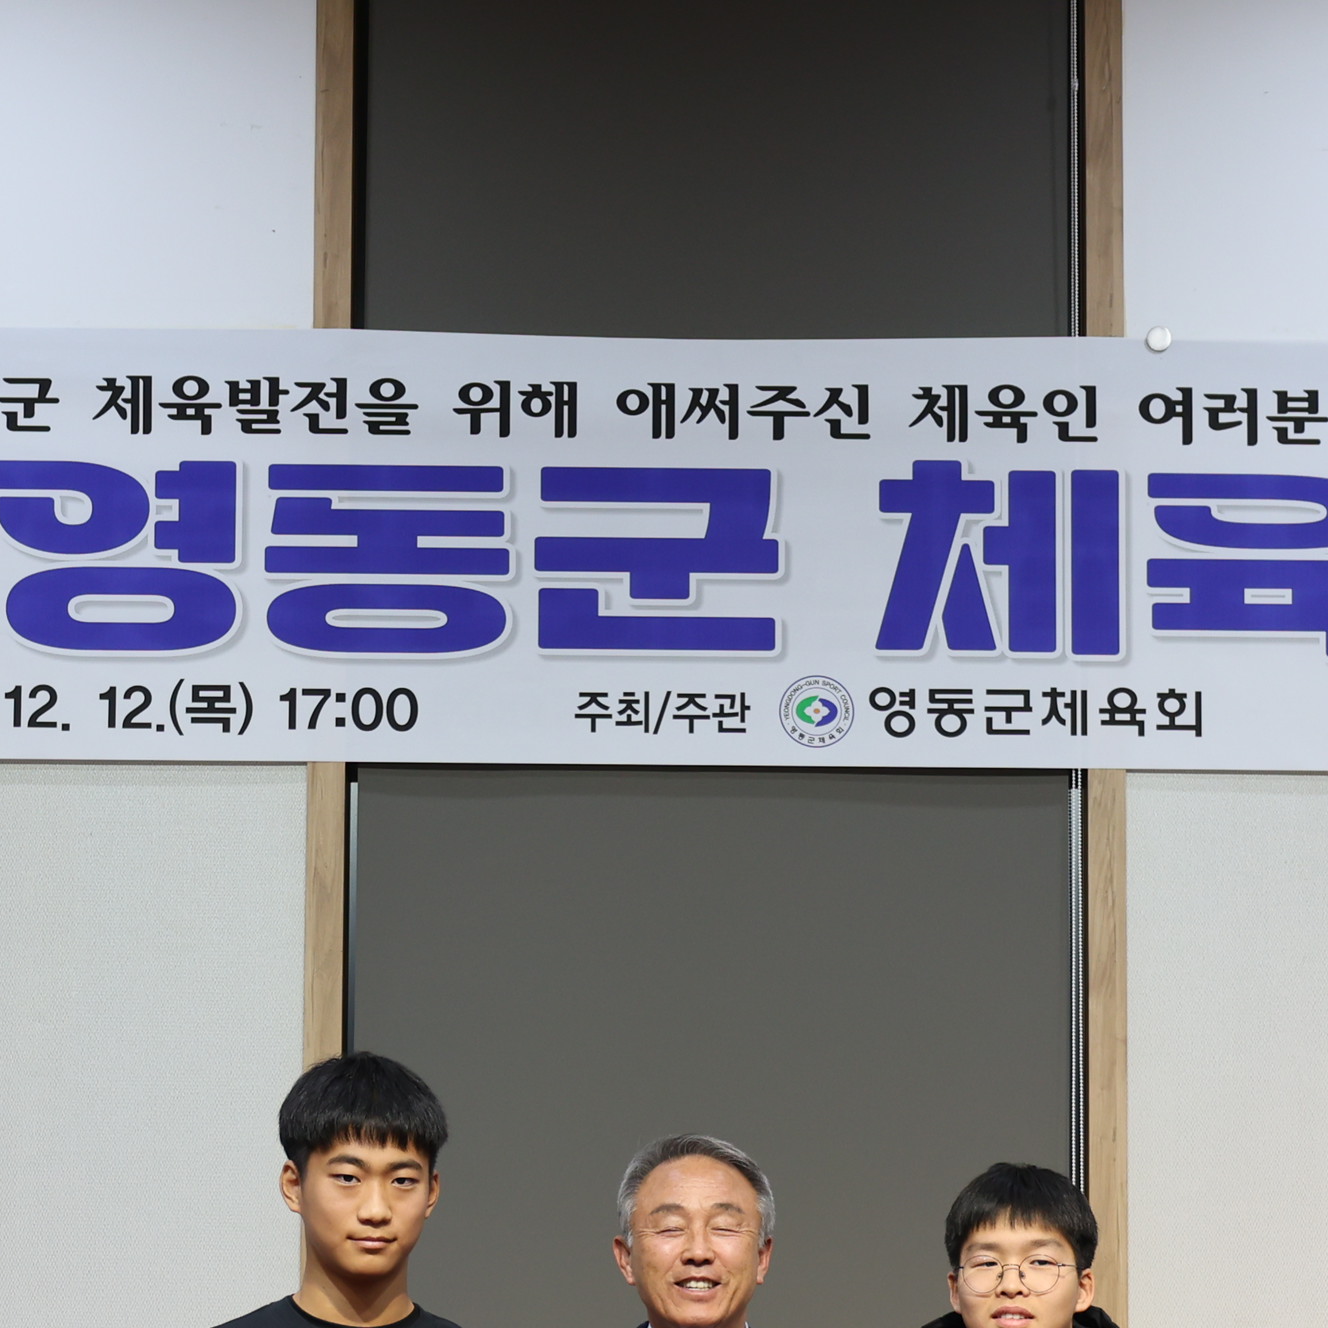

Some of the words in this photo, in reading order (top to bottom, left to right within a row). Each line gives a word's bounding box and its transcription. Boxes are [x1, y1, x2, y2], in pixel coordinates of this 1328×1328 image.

[92, 375, 419, 437] 체육발전을
[452, 380, 578, 439] 위해
[616, 382, 871, 442] 애써주신
[908, 384, 1099, 445] 체육인
[4, 684, 71, 732] 12.
[99, 678, 254, 736] 12.(목)
[279, 686, 420, 733] 17:00
[574, 690, 752, 736] 주최/주관
[821, 680, 842, 694] SPORT
[868, 686, 1203, 738] 영동군체육회
